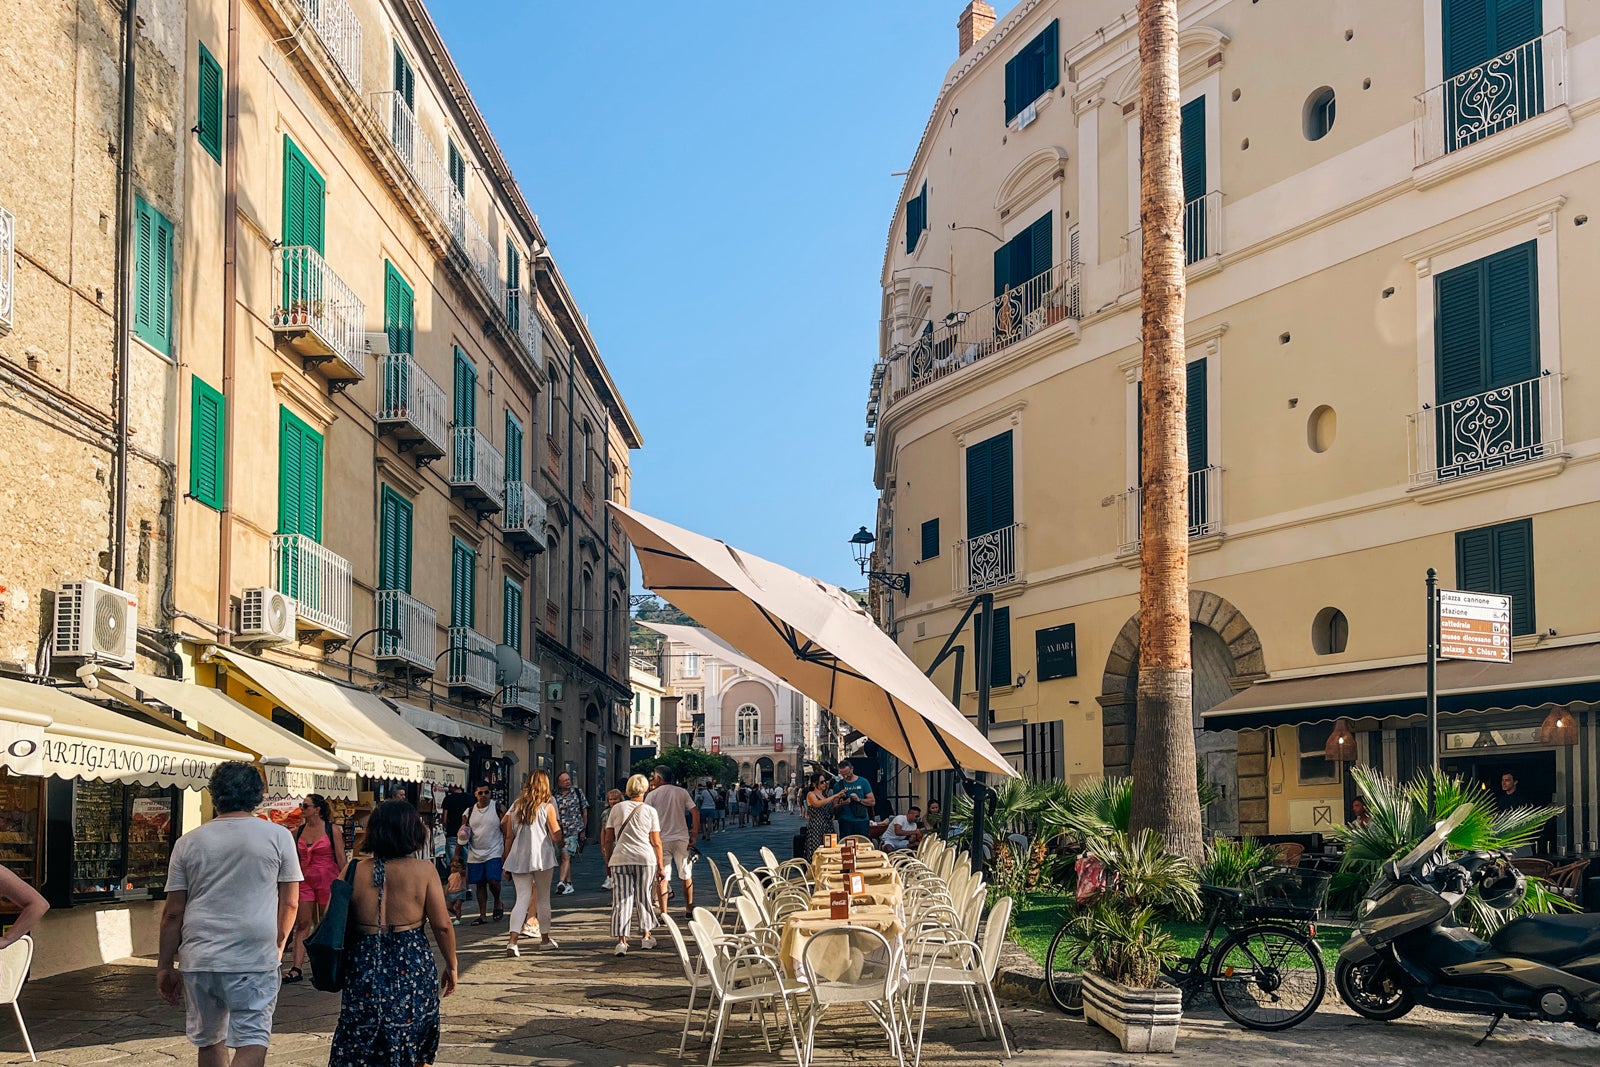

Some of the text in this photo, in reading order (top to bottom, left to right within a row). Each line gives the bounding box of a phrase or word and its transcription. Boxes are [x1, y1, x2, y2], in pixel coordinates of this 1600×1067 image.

[1442, 594, 1490, 604] piazza cannone
[1442, 608, 1468, 616] stazione
[1441, 621, 1470, 629] cattedrale
[1462, 634, 1491, 643] diocesano
[1442, 645, 1466, 654] palazzo
[1476, 647, 1497, 656] Chiara
[42, 740, 144, 773] ARTIGIANO
[147, 754, 177, 776] DEL
[352, 755, 376, 772] Polleria
[382, 759, 410, 777] Salumeria
[314, 774, 326, 790] DEL
